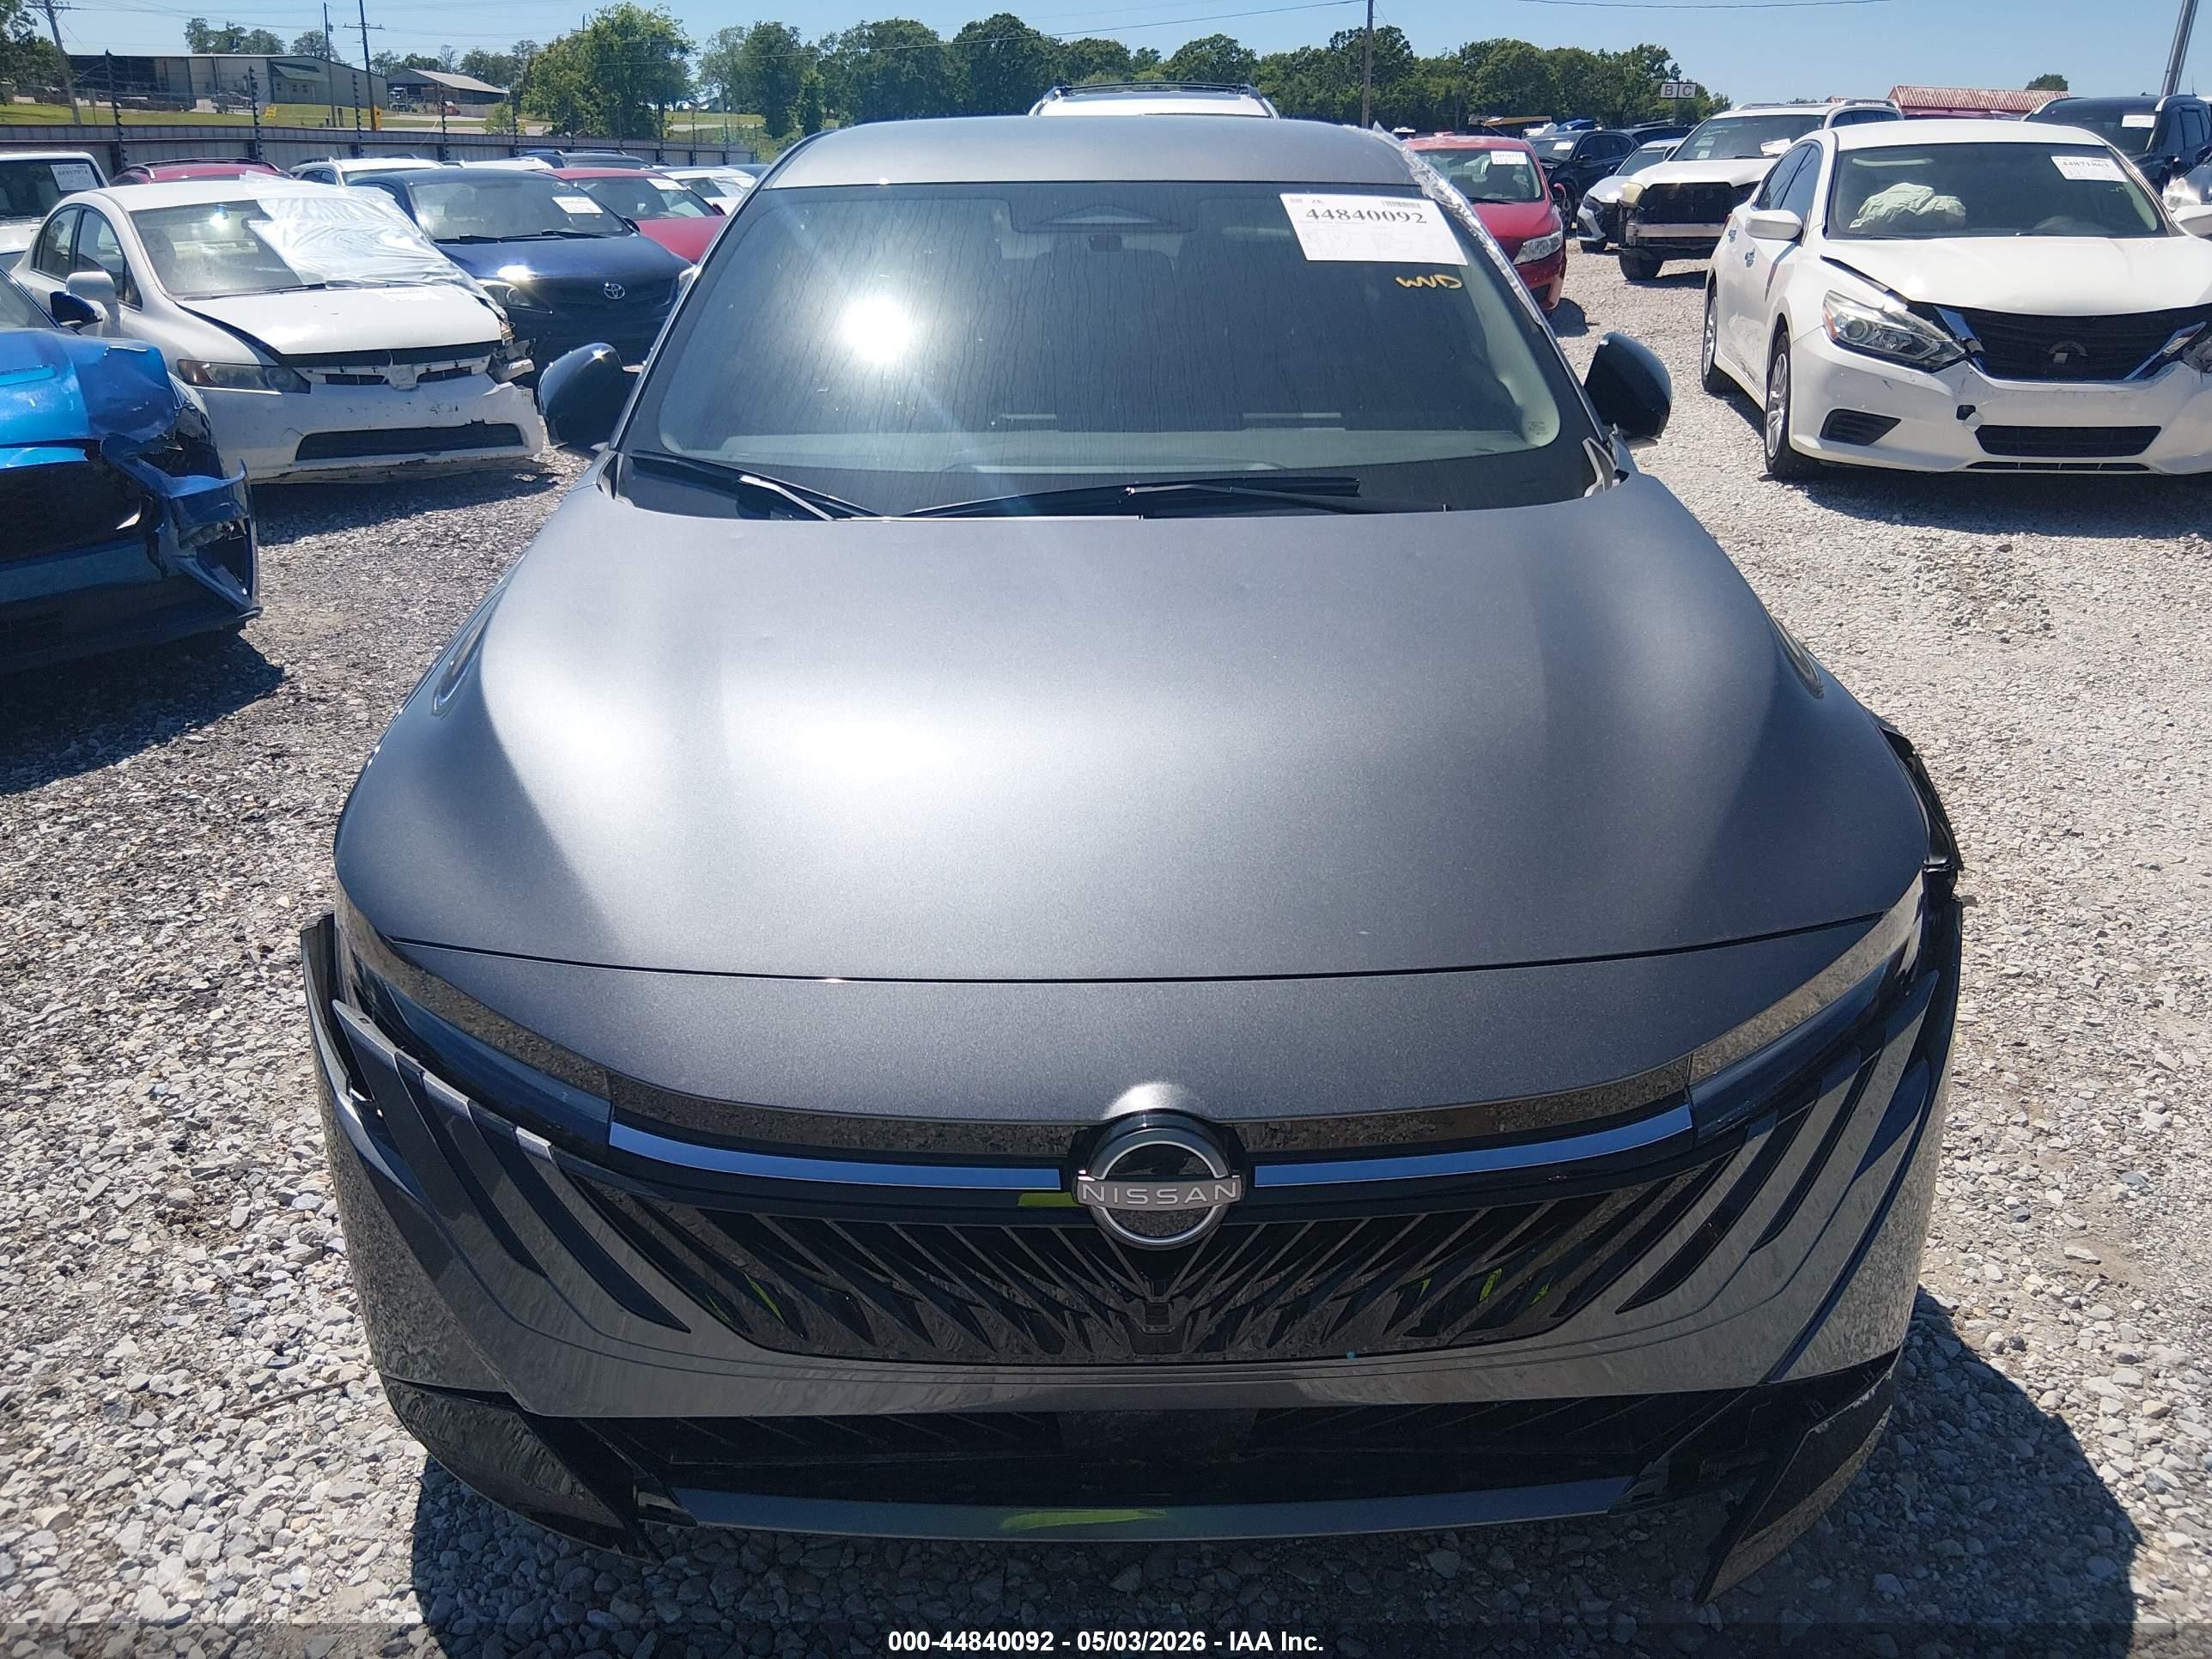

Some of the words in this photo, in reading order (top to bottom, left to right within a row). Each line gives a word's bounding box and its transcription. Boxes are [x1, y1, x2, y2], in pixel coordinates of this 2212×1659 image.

[1664, 84, 1674, 96] B
[1682, 84, 1692, 97] C
[1305, 208, 1428, 224] 44840092
[1081, 1182, 1237, 1205] NISSAN
